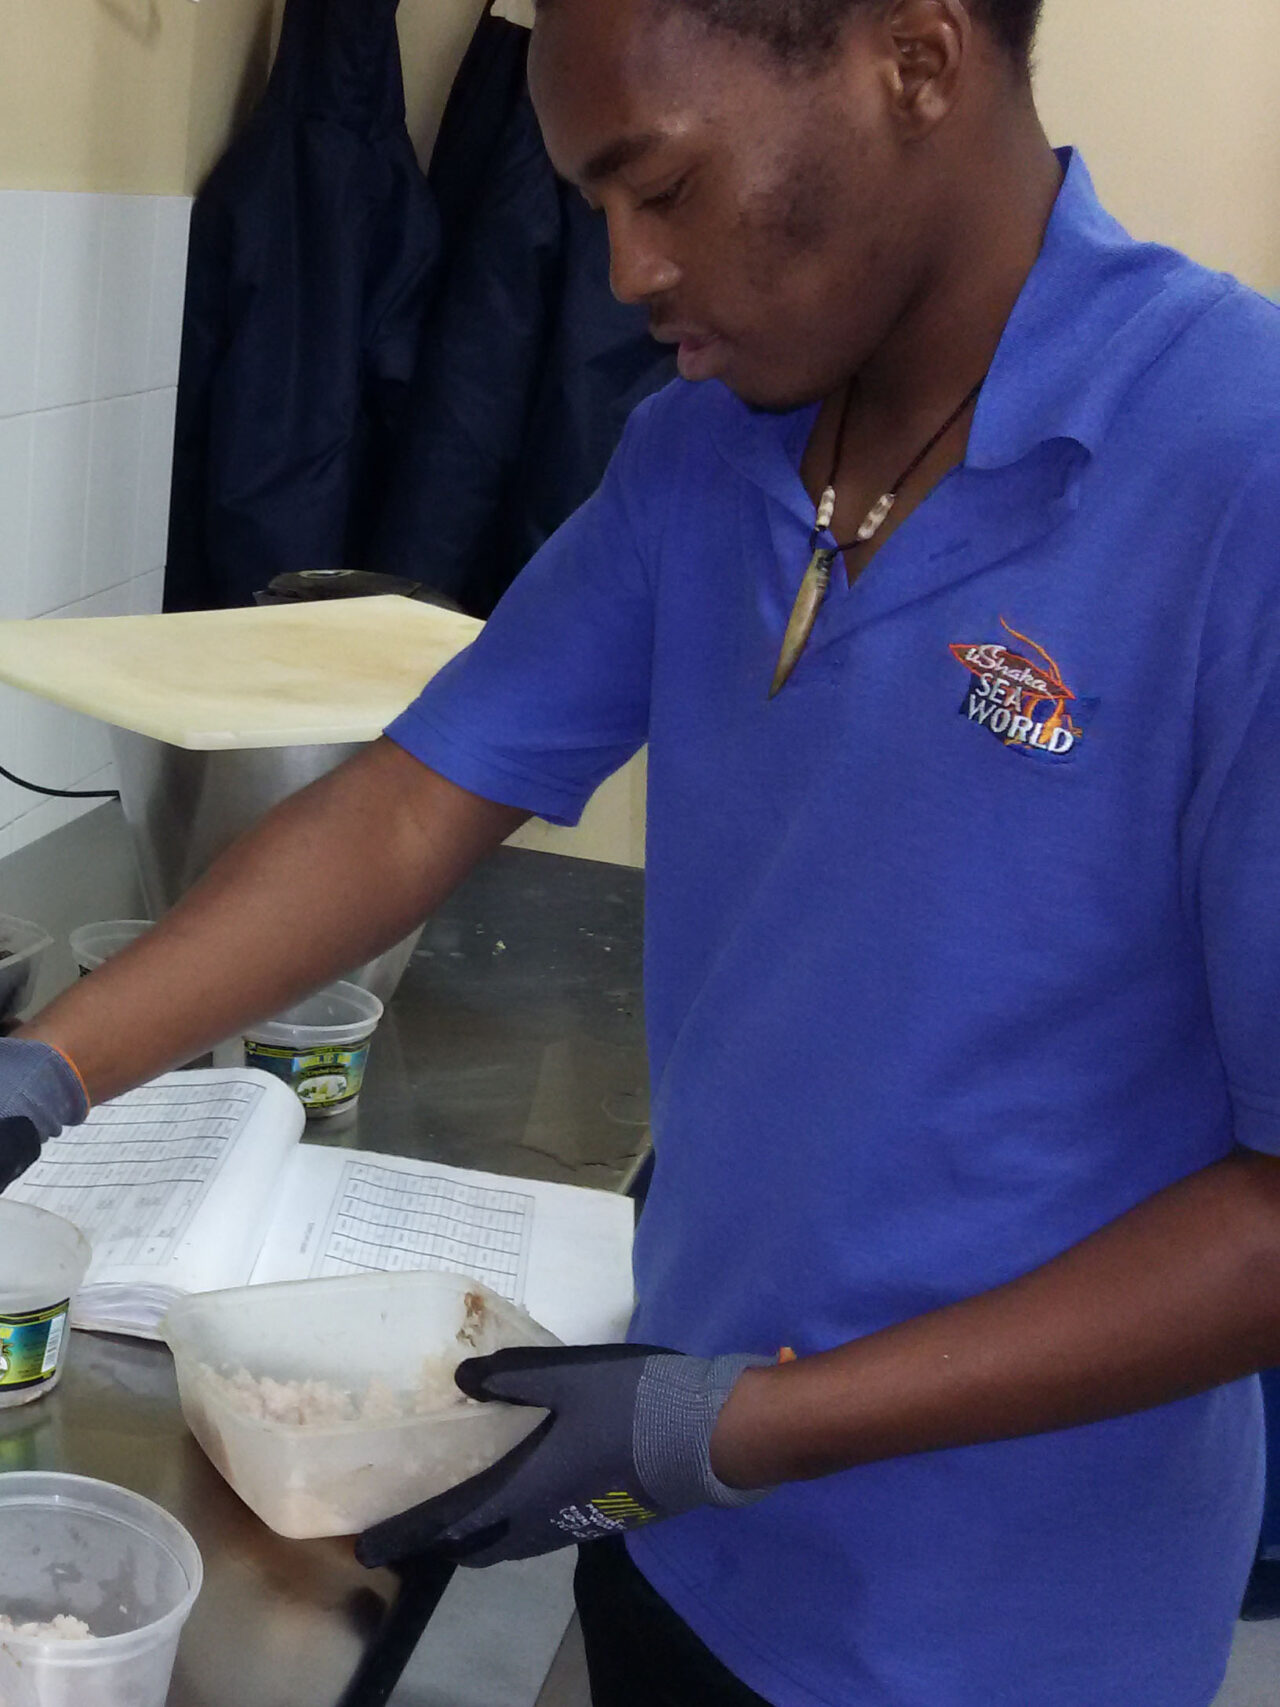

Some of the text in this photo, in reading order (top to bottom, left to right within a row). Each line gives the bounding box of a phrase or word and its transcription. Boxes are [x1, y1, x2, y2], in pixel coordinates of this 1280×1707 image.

[965, 644, 1052, 694] uShaka
[975, 673, 1022, 712] SEA
[968, 694, 1074, 753] WORLD
